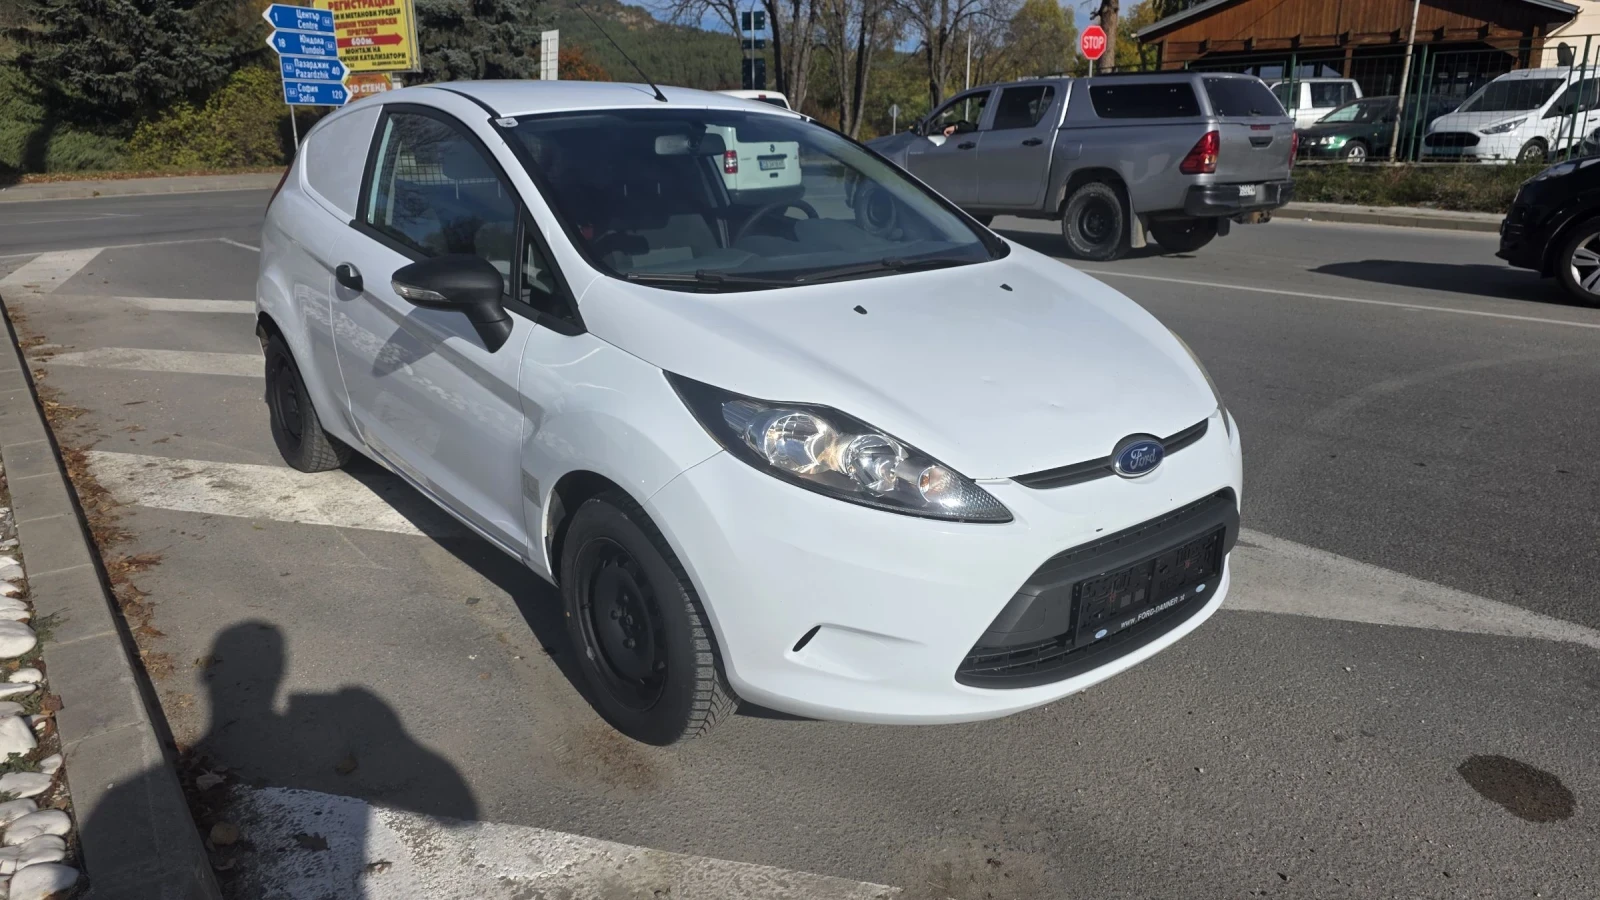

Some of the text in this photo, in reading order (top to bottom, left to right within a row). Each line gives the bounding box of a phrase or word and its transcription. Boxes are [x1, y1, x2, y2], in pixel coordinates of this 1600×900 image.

[274, 12, 279, 22] 1
[295, 9, 320, 22] Център
[345, 10, 377, 19] МЕТАНОВИ
[378, 7, 401, 16] УРЕДБИ
[297, 19, 319, 30] Centre
[277, 38, 286, 48] 18
[299, 34, 325, 45] Юндола
[1083, 35, 1104, 49] STOP
[300, 44, 326, 55] Yundola
[360, 52, 406, 60] КАТАЛИЗАТОРИ
[293, 58, 330, 70] Пазарджик
[295, 68, 330, 79] Pazardzhik
[331, 66, 341, 76] 40
[297, 83, 319, 93] София
[298, 93, 316, 103] Sofia
[331, 90, 343, 99] 120
[1130, 446, 1156, 470] Ford
